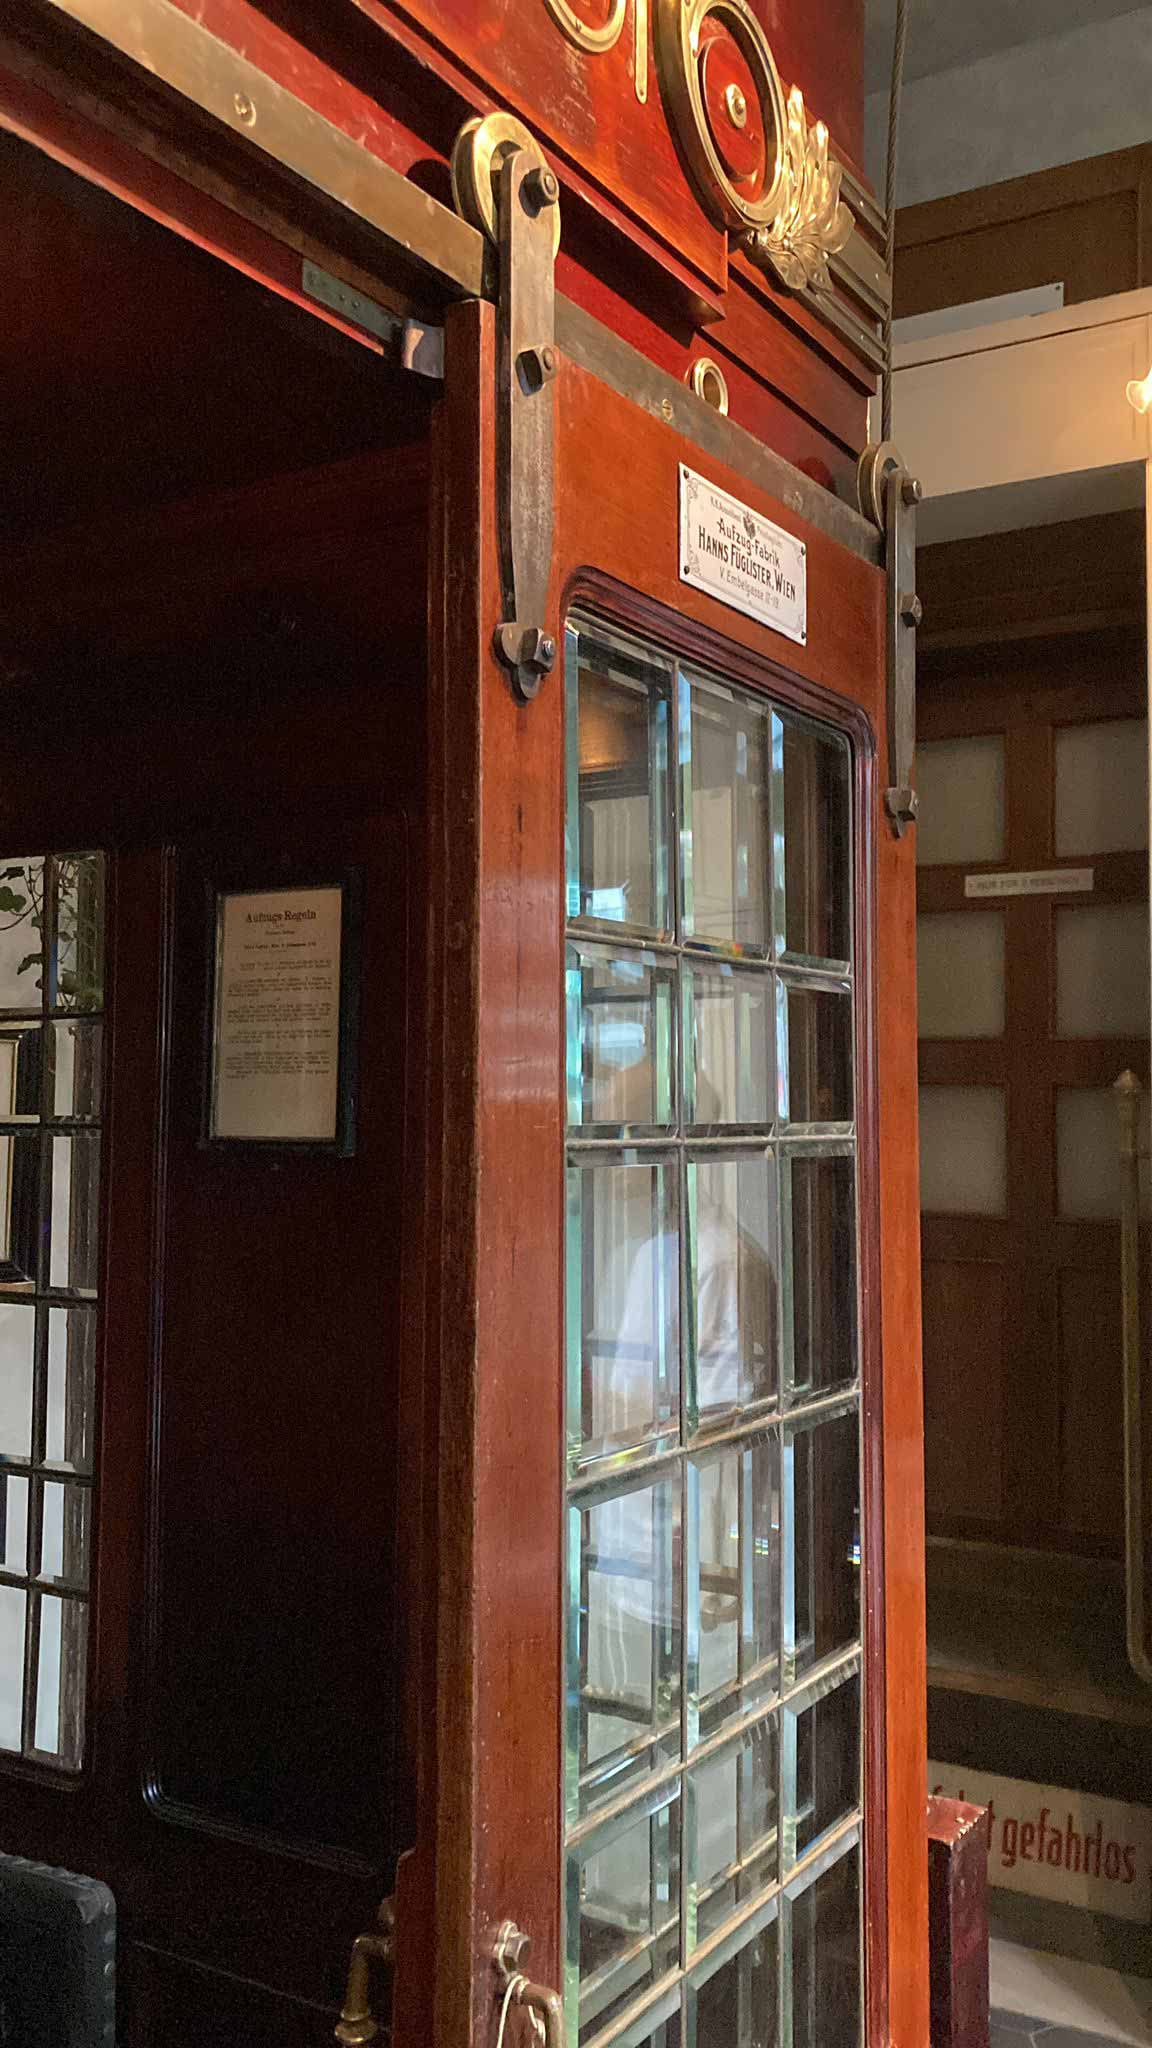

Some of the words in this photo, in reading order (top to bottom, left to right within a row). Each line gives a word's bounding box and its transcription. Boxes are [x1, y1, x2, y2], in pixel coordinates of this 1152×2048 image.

[698, 526, 728, 563] HANNS
[774, 568, 796, 602] WIEN
[717, 518, 780, 568] Aufzug-Fabrik
[1001, 1807, 1137, 1883] gefahrlos
